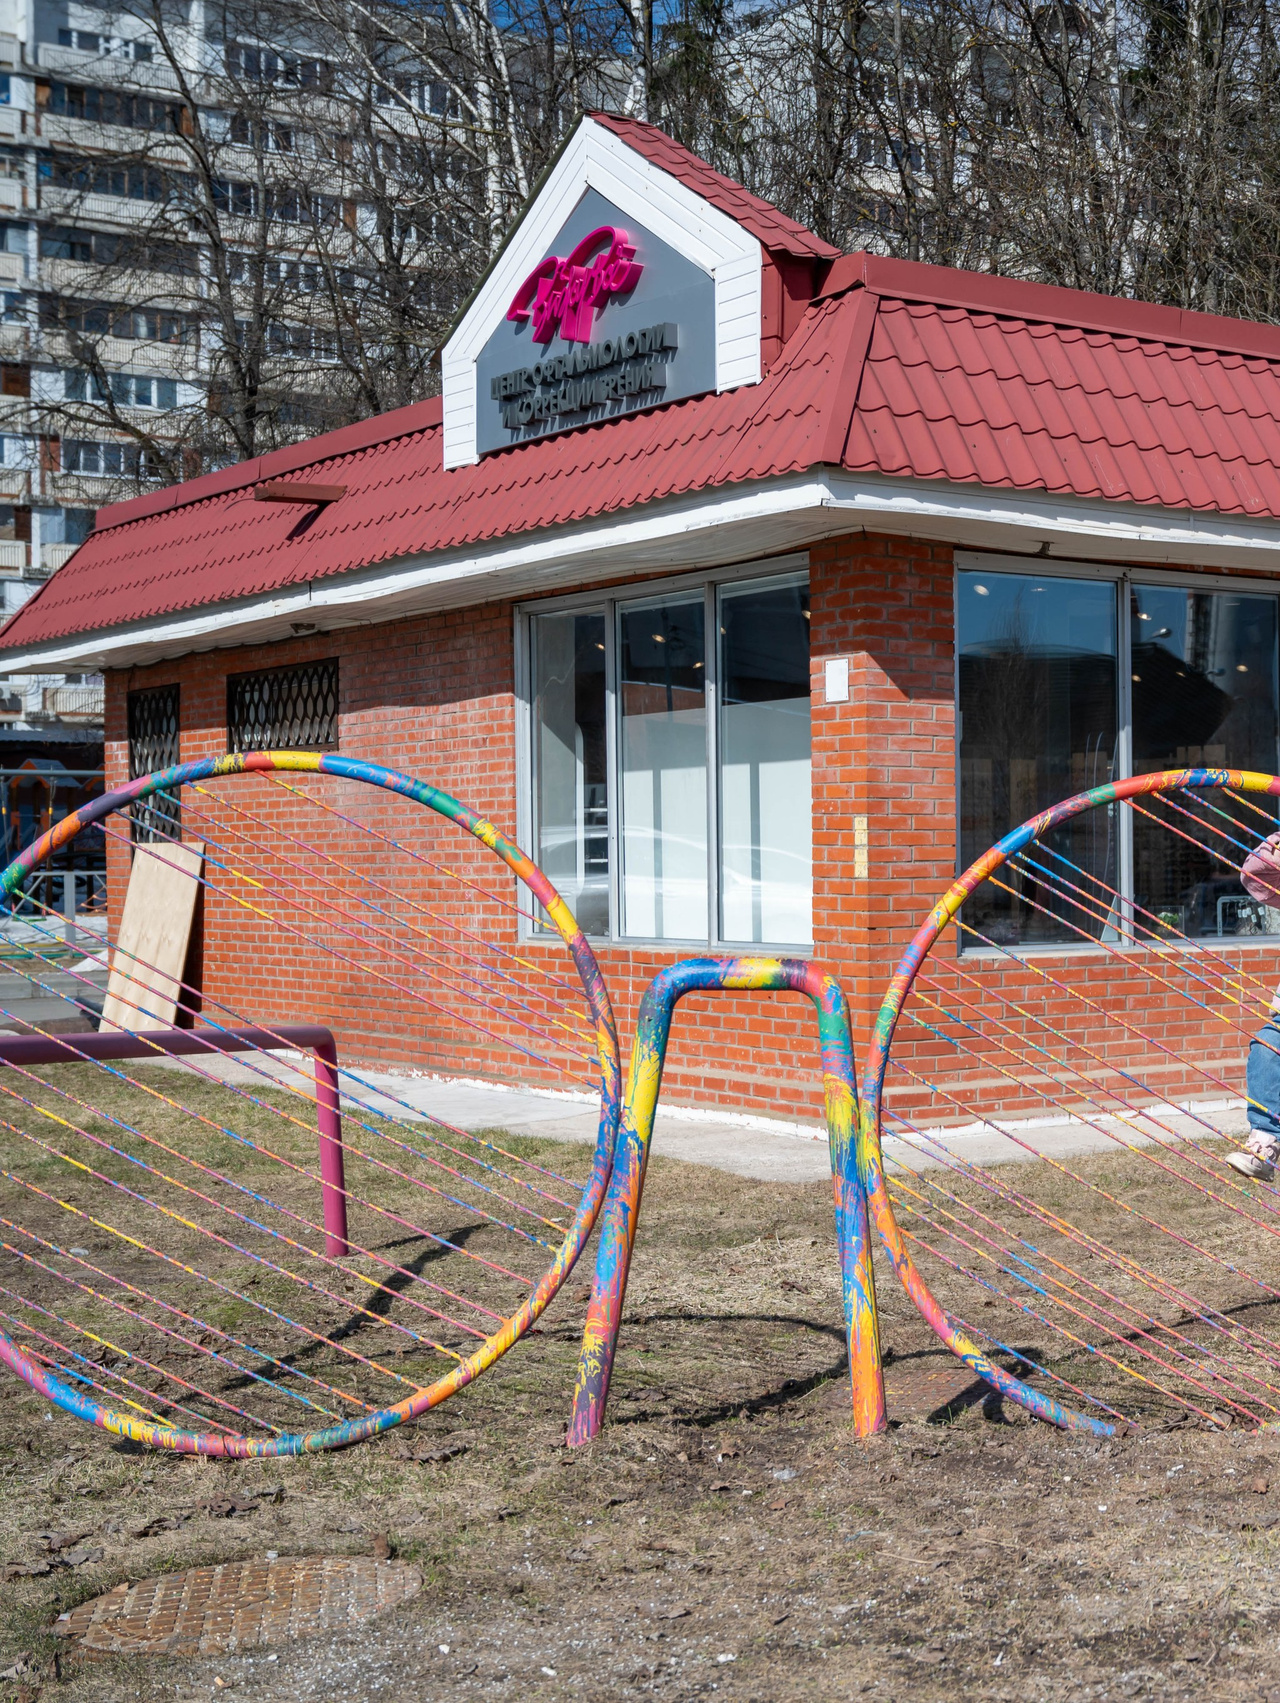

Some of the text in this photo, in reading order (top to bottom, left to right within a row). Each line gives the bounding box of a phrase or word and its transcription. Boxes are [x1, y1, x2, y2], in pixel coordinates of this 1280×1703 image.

[491, 322, 678, 400] ЦЕНТР ОФТАЛЬМОЛОГИИ
[515, 381, 604, 425] КОРРЕКЦИИ
[601, 362, 666, 400] ЗРЕНИЯ
